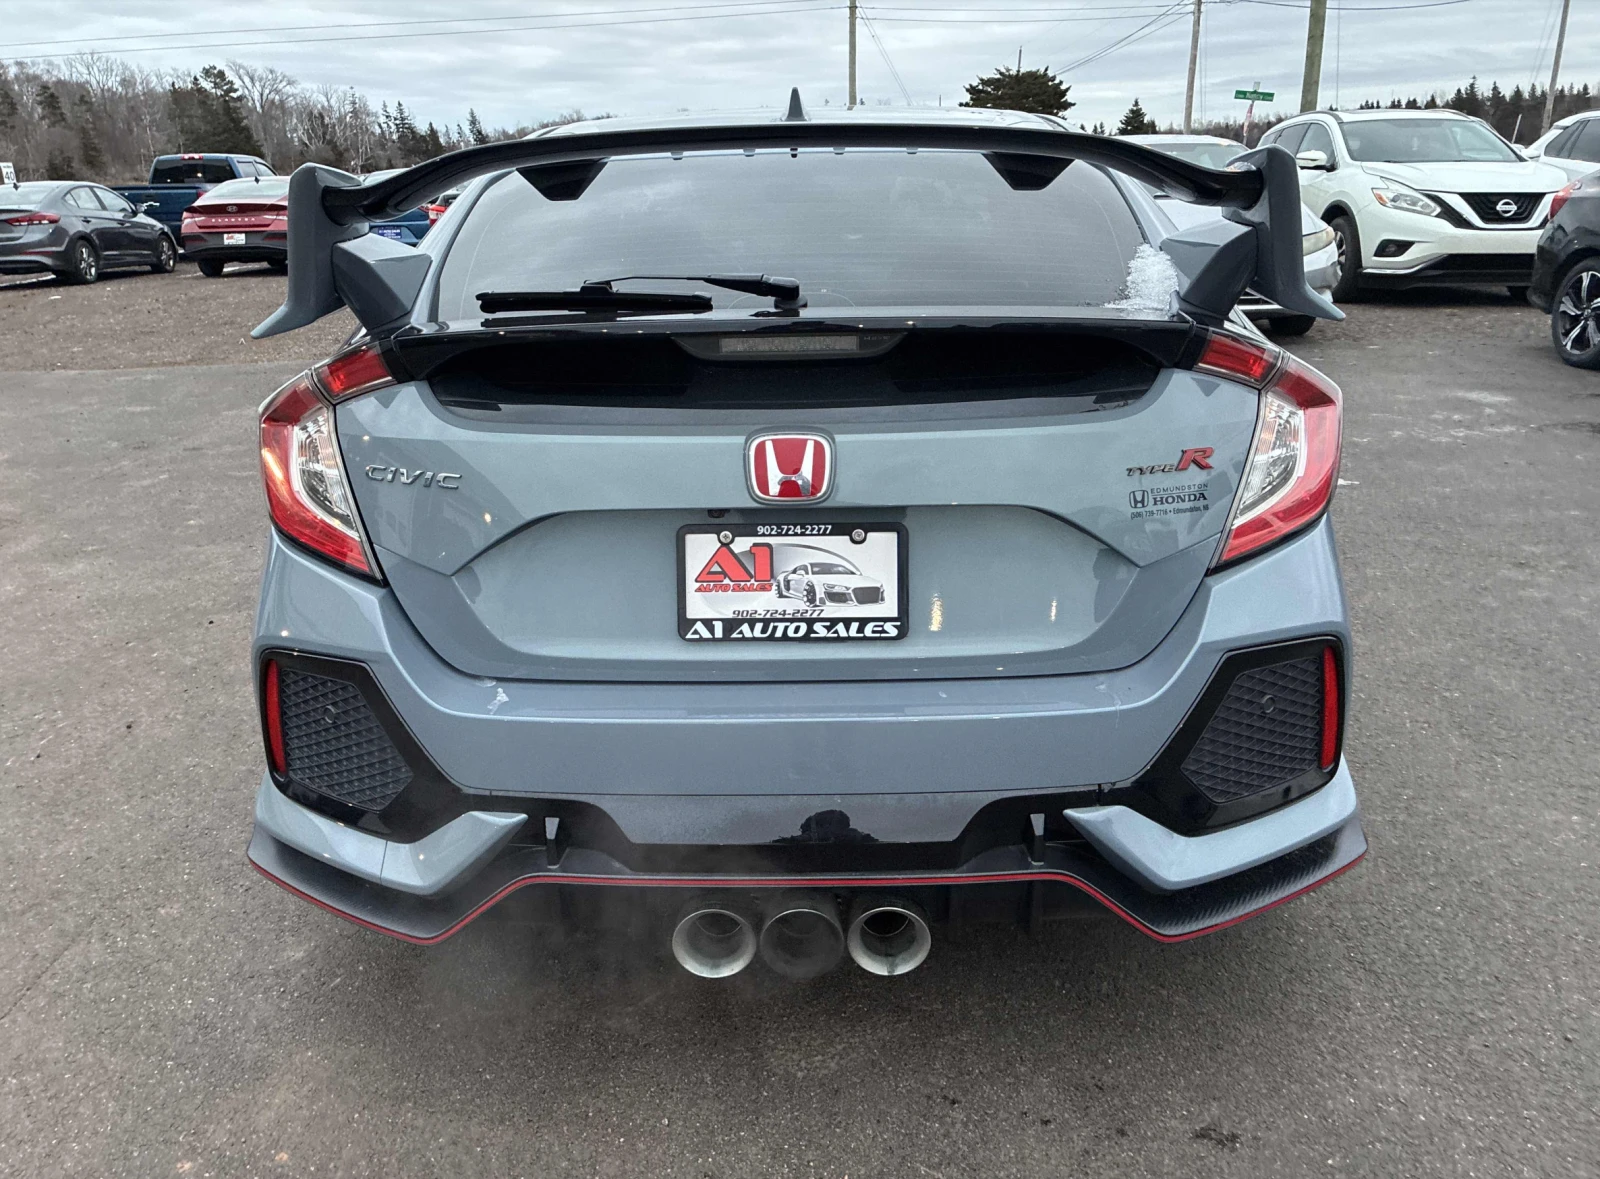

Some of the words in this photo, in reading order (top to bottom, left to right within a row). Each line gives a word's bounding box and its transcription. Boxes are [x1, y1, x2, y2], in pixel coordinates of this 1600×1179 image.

[1126, 463, 1175, 477] TYPE
[1175, 446, 1214, 471] R
[365, 464, 462, 490] CIVIC
[1150, 483, 1208, 494] EDMUNDSTON
[1152, 492, 1208, 506] HONDA
[757, 525, 832, 535] 902-724-2277
[694, 542, 774, 583] A1
[694, 583, 731, 592] AUTO
[731, 582, 773, 592] SALES
[732, 609, 825, 618] 902-724-2277
[685, 620, 724, 639] A1
[730, 621, 808, 638] AUTO
[810, 621, 901, 638] SALES
